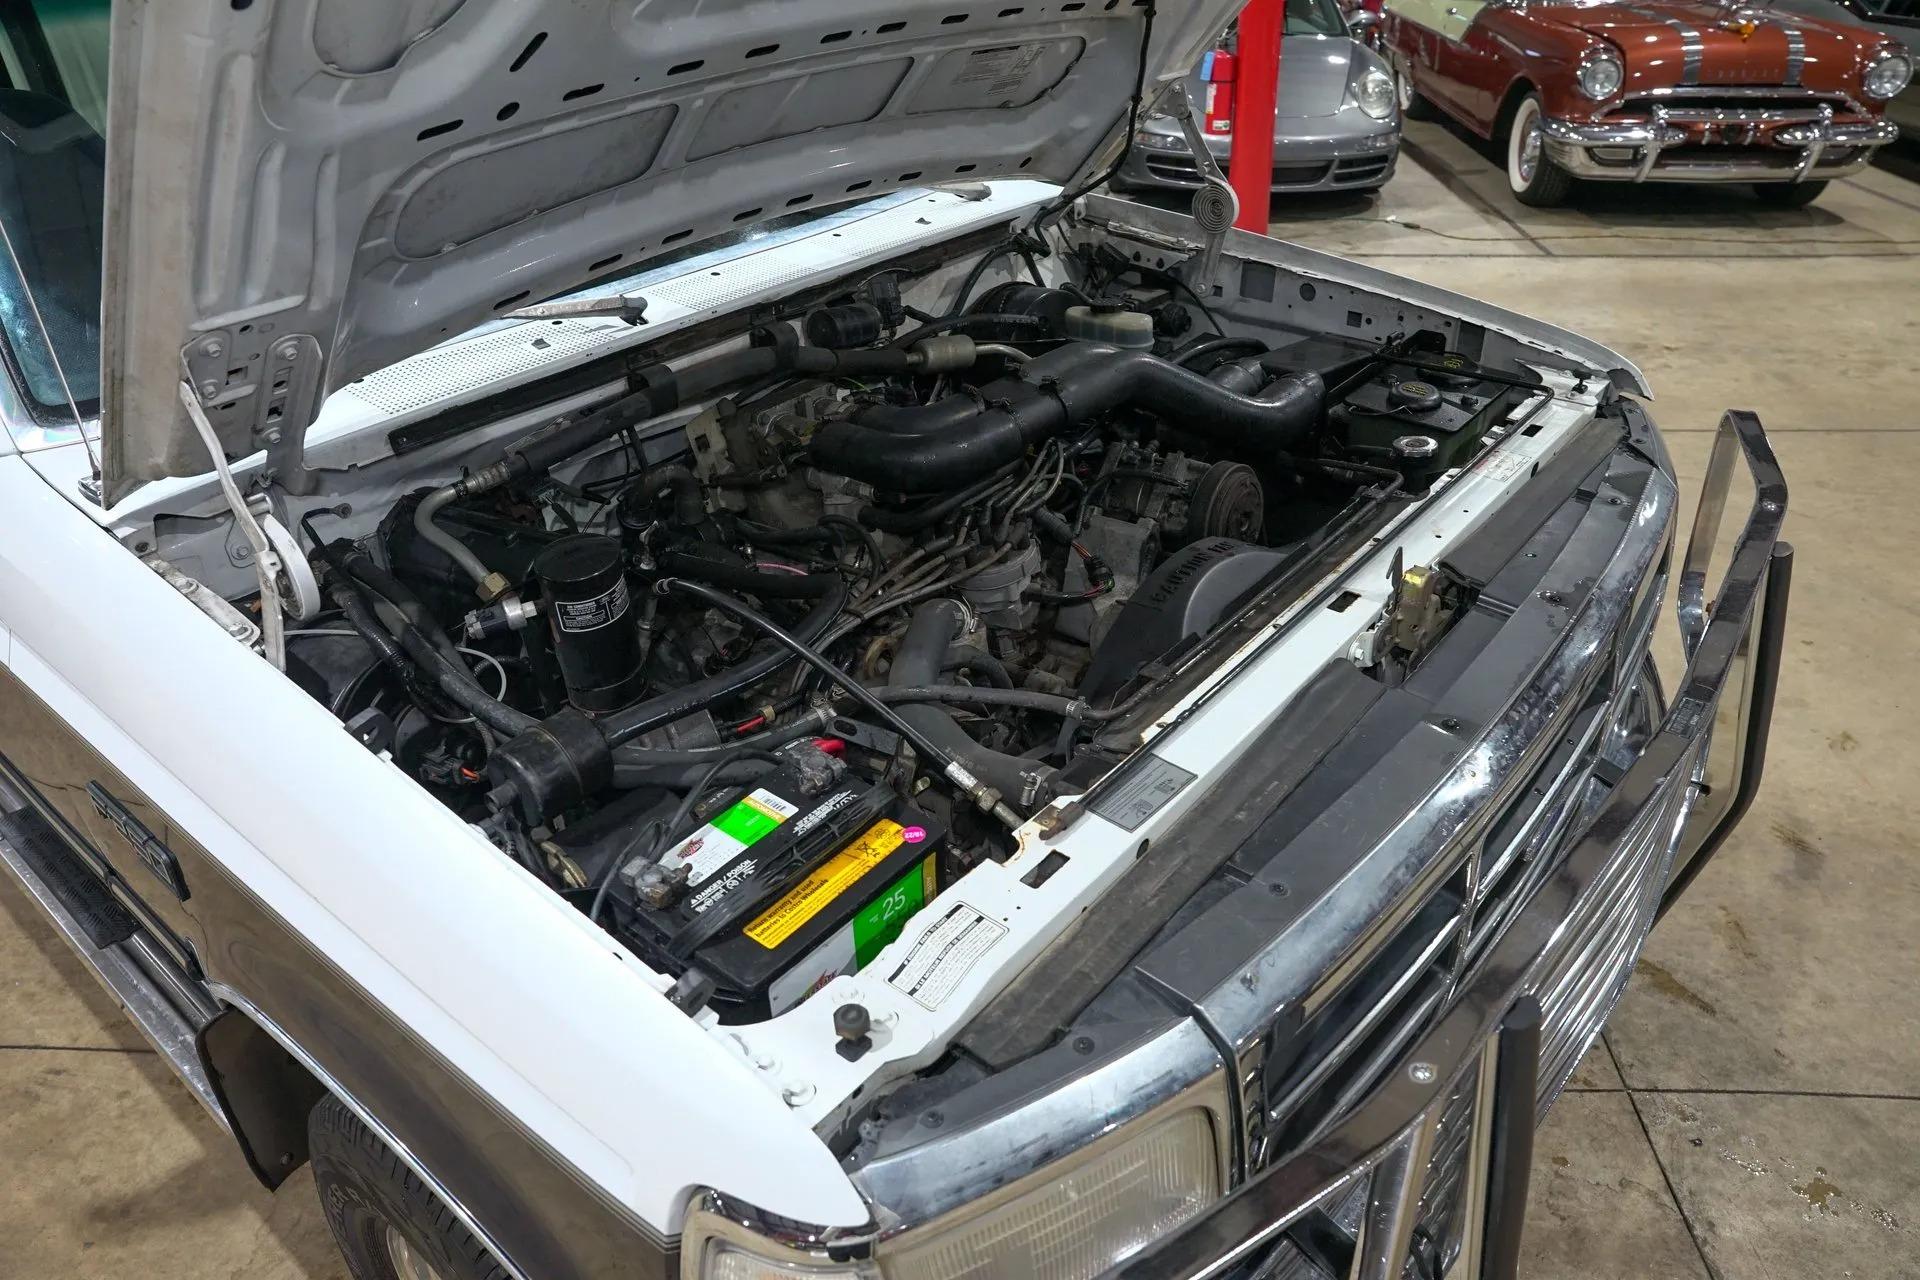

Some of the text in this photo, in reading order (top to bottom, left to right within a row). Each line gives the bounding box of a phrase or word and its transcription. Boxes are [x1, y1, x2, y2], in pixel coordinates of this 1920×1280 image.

[696, 879, 722, 900] DANGER
[726, 858, 750, 877] POISON
[748, 880, 814, 933] Return warranty and used
[755, 917, 781, 937] batteries
[784, 899, 803, 915] Costco
[801, 879, 829, 901] Wholesale
[882, 887, 906, 921] 25
